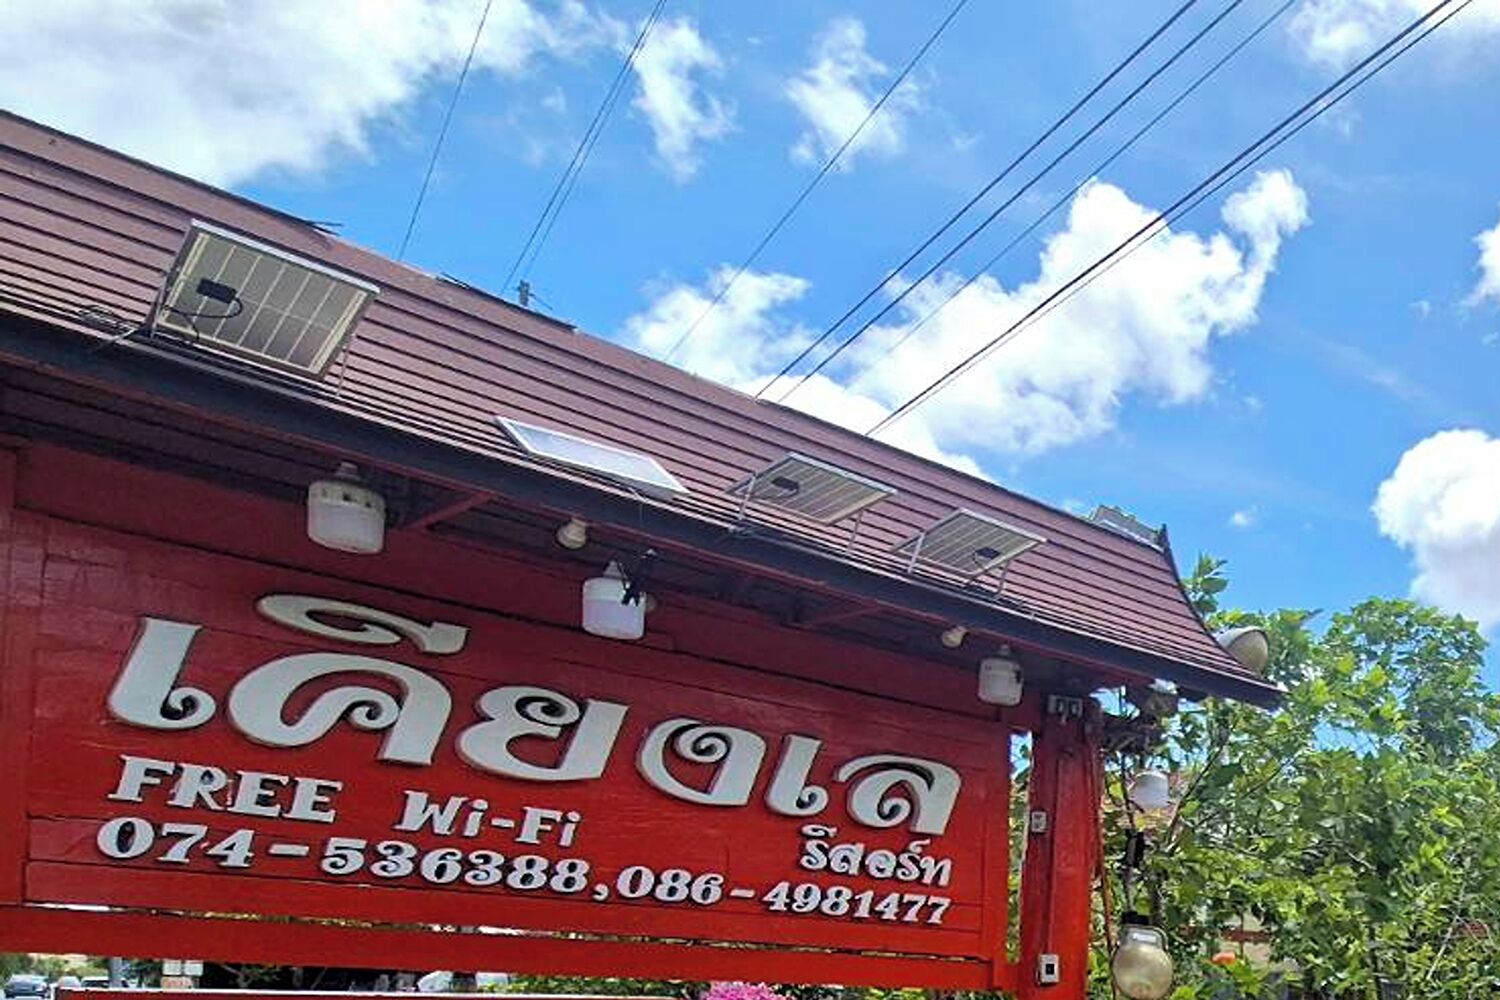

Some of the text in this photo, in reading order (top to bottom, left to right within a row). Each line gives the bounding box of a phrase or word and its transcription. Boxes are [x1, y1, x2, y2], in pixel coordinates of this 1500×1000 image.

[107, 593, 963, 836] เคียงเล
[107, 754, 581, 848] FREE Wi-Fi
[800, 824, 952, 886] รีสอร์ท
